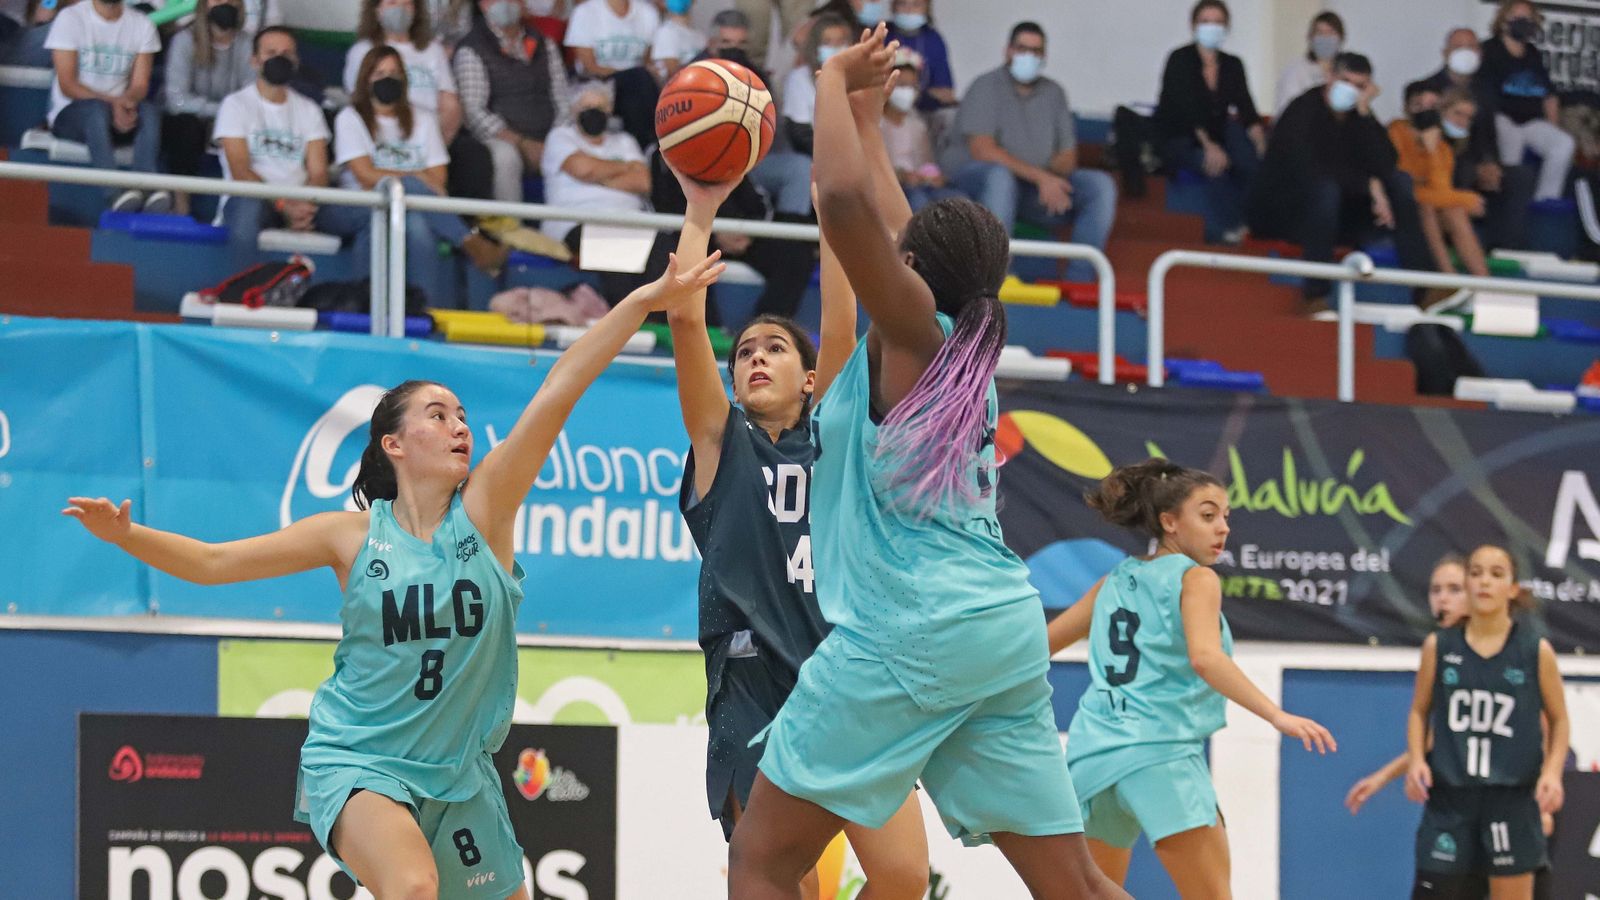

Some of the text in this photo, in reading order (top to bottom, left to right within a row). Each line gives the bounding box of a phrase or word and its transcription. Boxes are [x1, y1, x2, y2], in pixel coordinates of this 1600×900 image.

[485, 424, 694, 497] alonc
[513, 495, 702, 562] ndalu
[1240, 543, 1346, 575] Europea
[1350, 547, 1391, 573] del
[381, 578, 484, 647] MLG
[1280, 578, 1349, 606] 2021
[1104, 606, 1141, 687] 9
[414, 649, 445, 701] 8
[1448, 689, 1516, 739] CDZ
[1466, 737, 1491, 779] 11
[452, 827, 482, 868] 8
[1490, 821, 1511, 853] 11
[466, 871, 496, 888] vive
